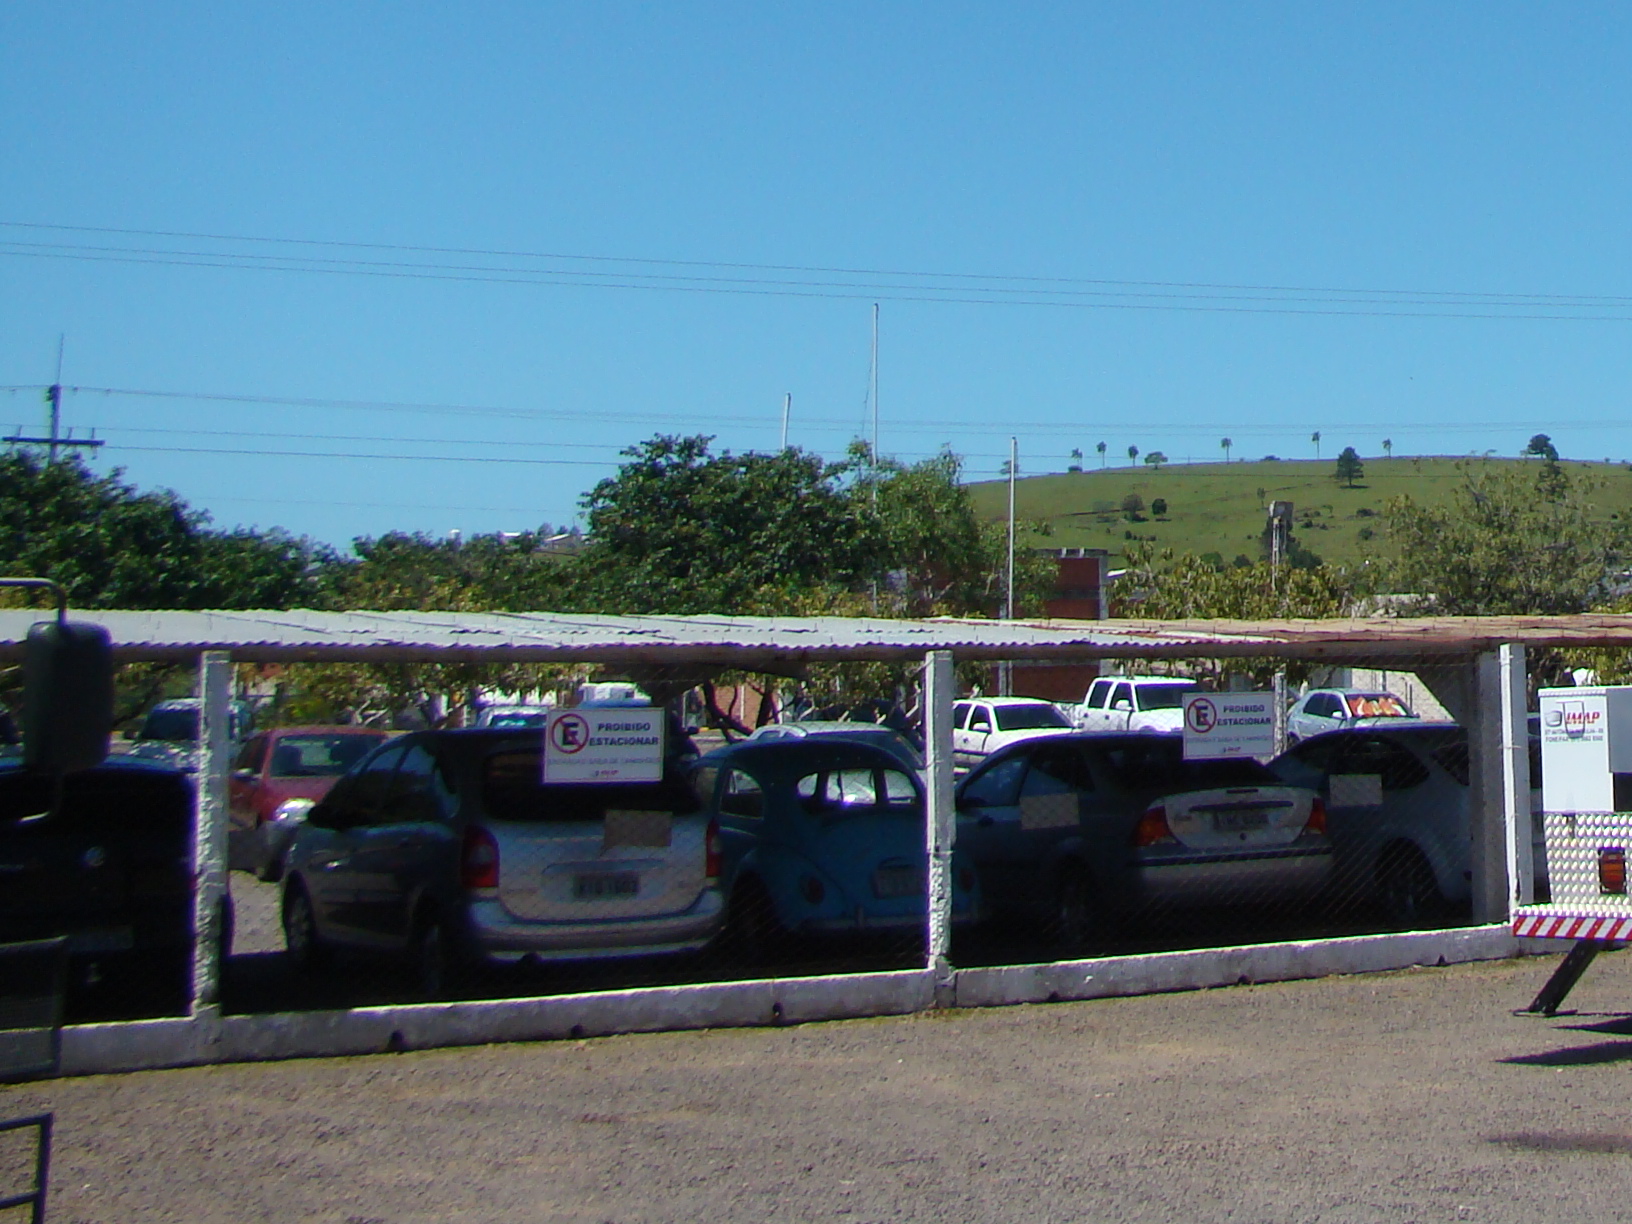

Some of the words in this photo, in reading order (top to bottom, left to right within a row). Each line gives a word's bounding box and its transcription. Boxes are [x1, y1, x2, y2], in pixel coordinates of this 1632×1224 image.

[1223, 704, 1265, 713] PROIBIDO
[1216, 717, 1272, 726] ESTACIONAR
[1566, 711, 1601, 725] IMAP
[597, 721, 652, 732] PROIBIDO
[589, 736, 660, 747] ESTACIONAR
